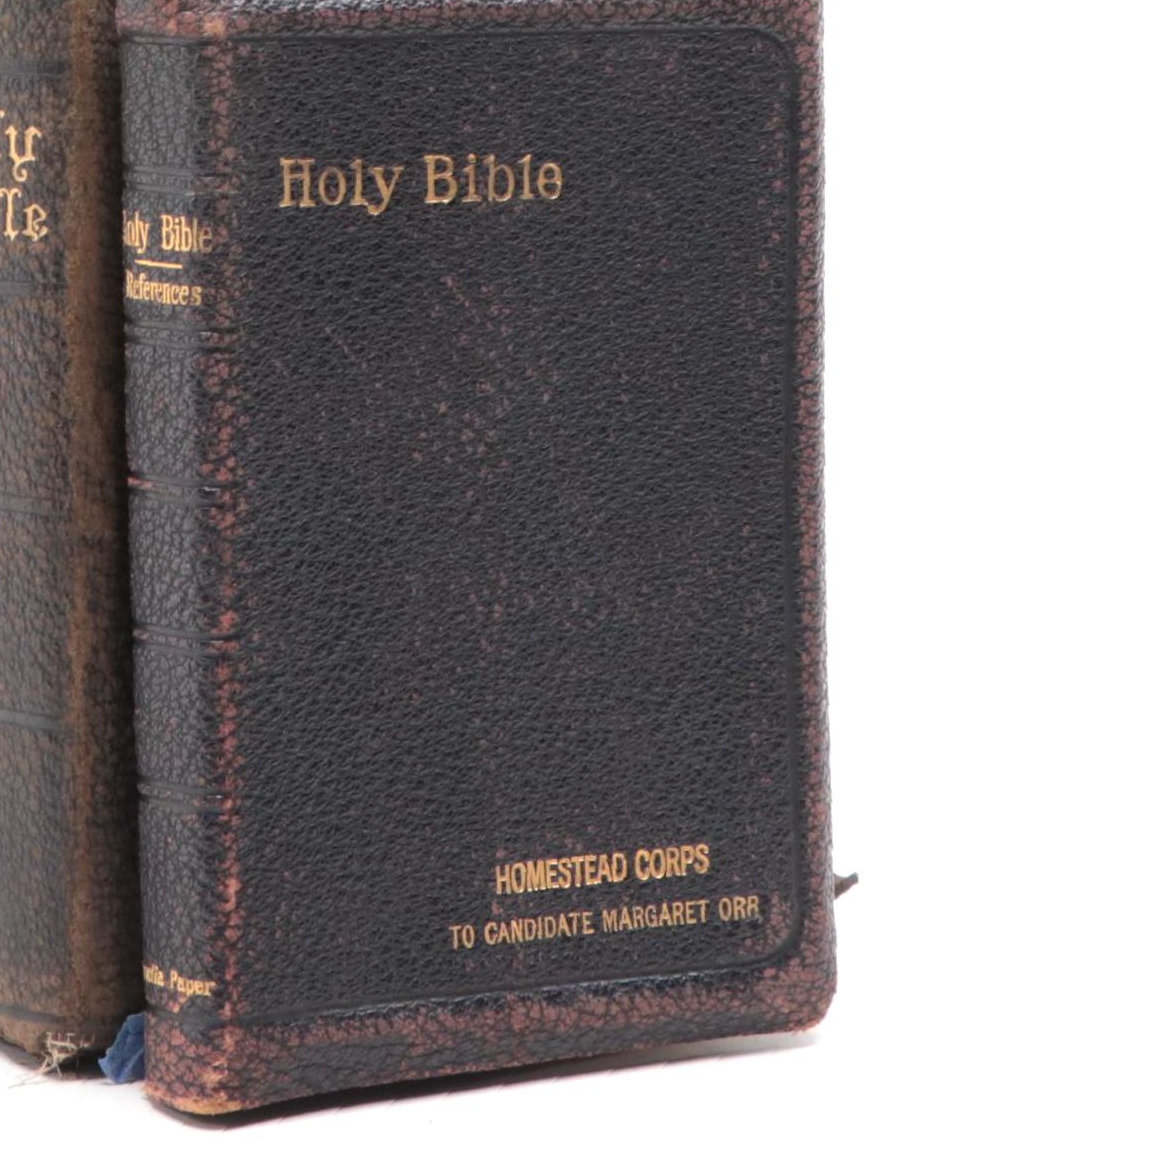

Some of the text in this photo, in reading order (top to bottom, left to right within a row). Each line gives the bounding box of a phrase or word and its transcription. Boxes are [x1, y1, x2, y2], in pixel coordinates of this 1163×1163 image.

[279, 152, 563, 215] Holy Bible
[160, 214, 213, 254] Bible
[125, 269, 203, 306] References
[495, 843, 711, 896] HOMESTEAD CORPS
[449, 894, 759, 950] TO CANDIDATE MARGARET ORR
[170, 969, 216, 997] Paper
